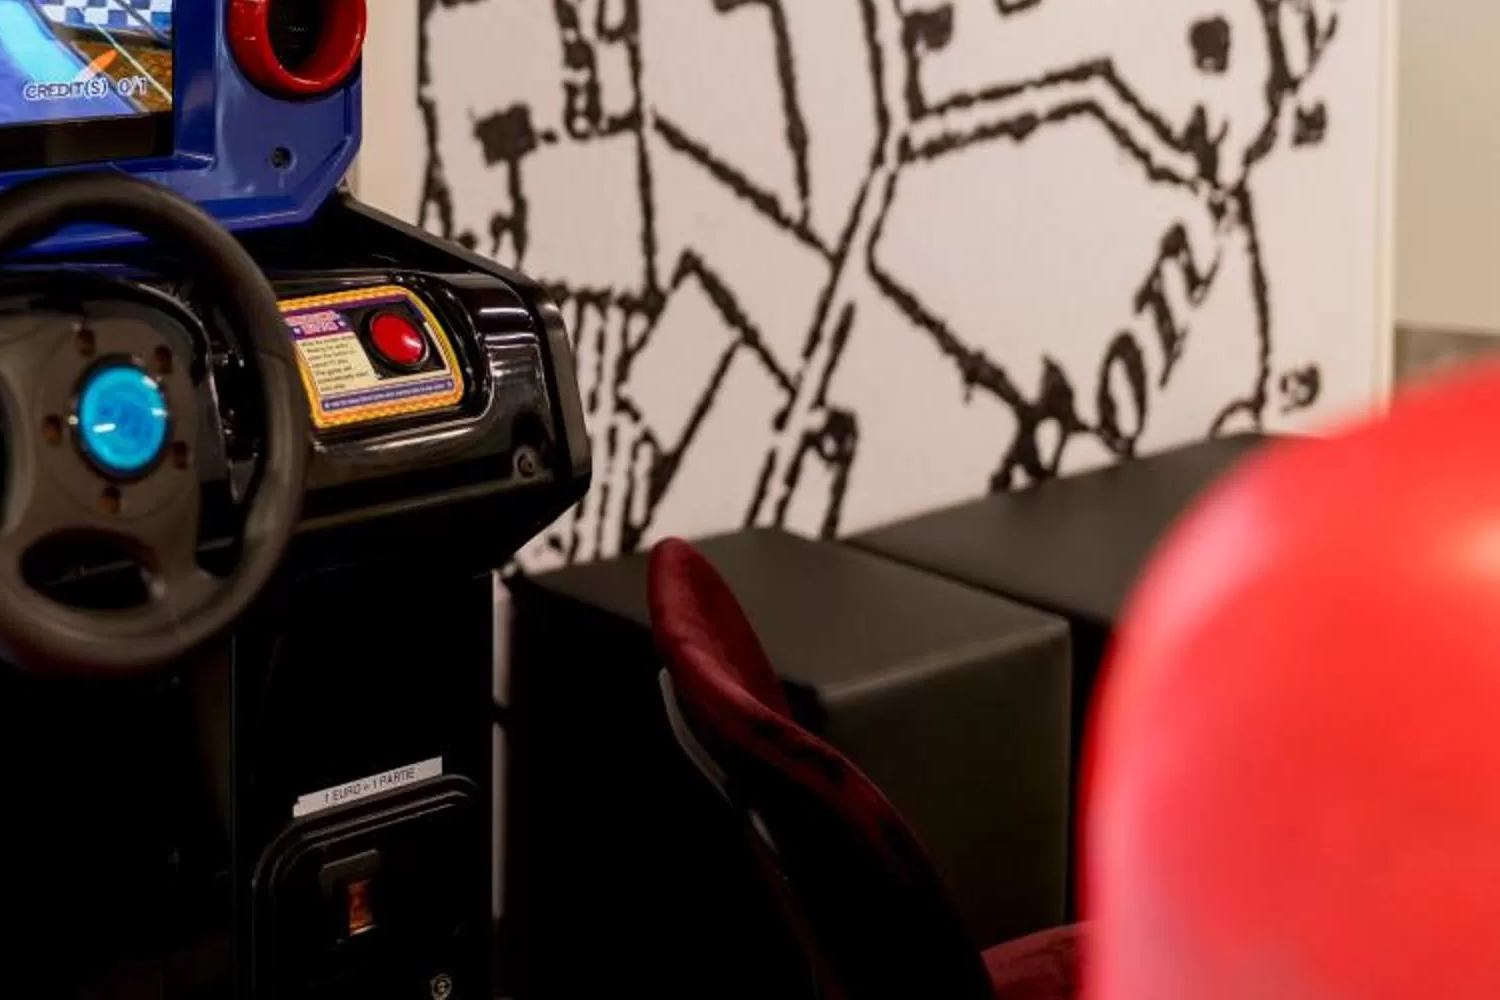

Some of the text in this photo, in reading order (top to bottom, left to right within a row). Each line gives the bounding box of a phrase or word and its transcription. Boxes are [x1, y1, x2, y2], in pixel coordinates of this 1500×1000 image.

[24, 75, 148, 101] CREDIT(S) 0/1
[332, 783, 361, 801] EURO
[380, 767, 415, 786] PARTIE
